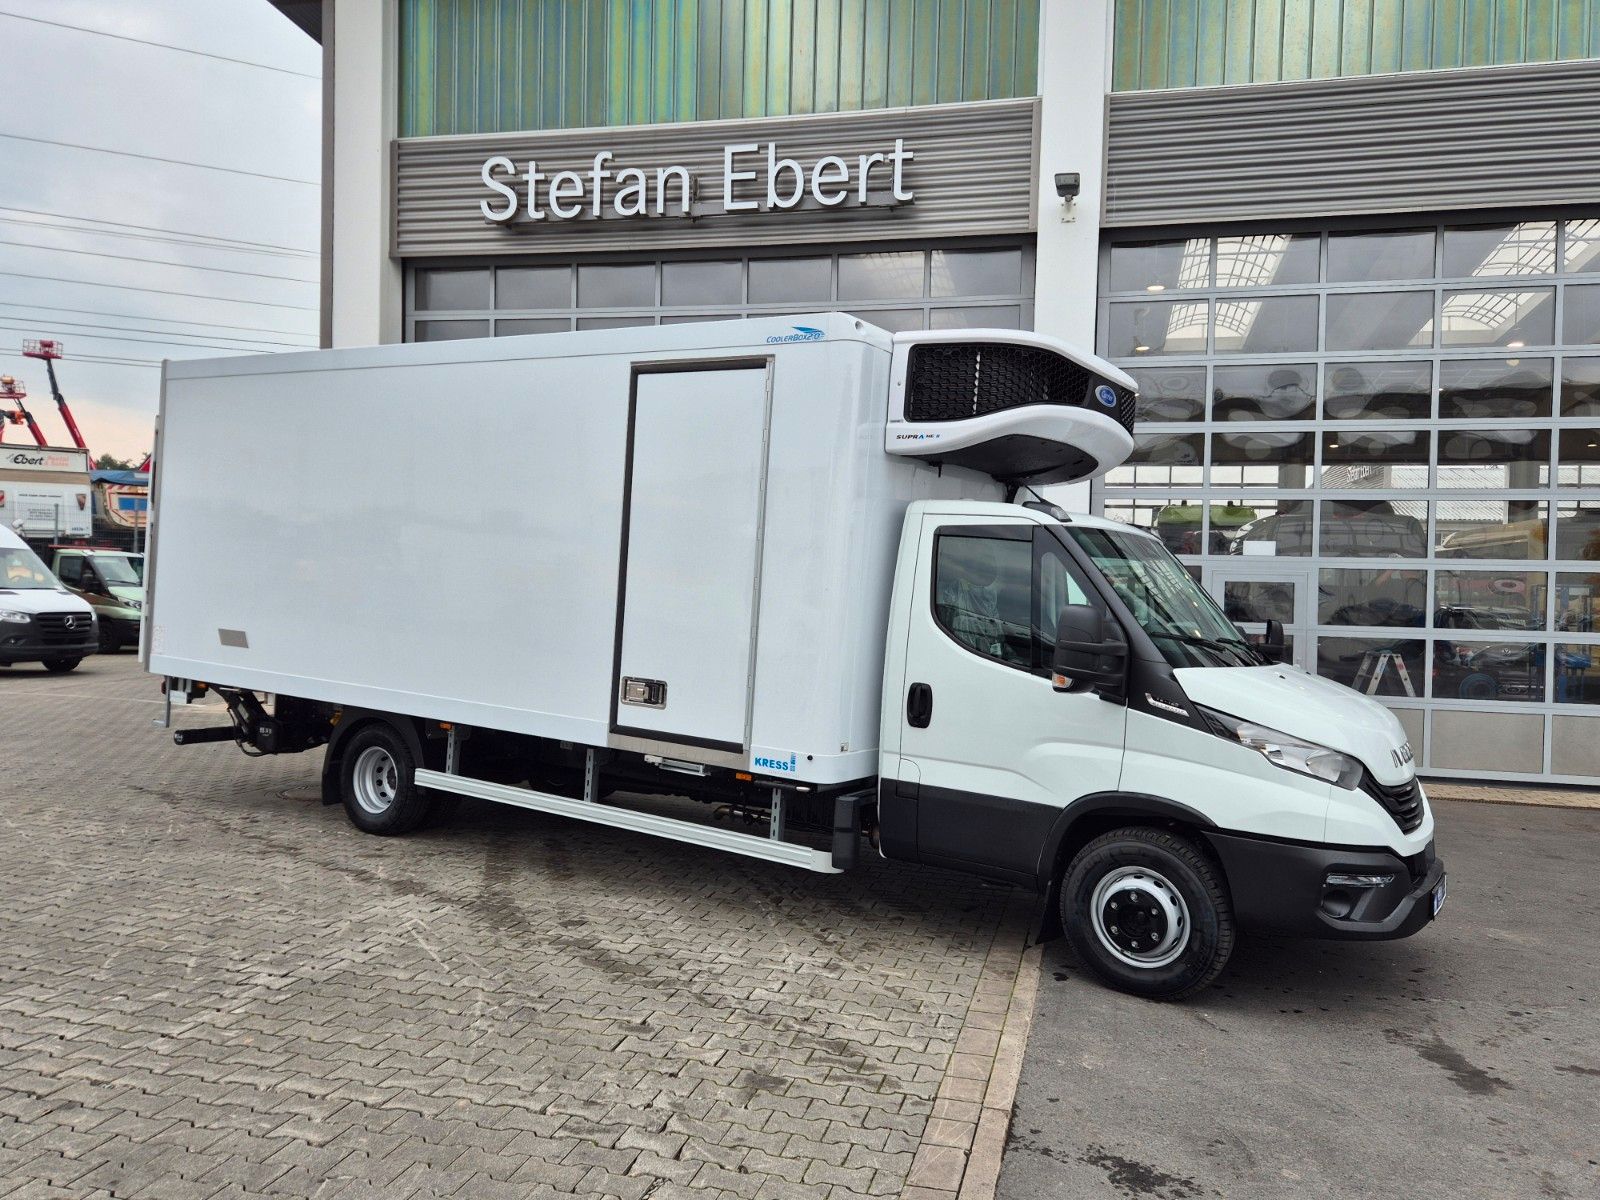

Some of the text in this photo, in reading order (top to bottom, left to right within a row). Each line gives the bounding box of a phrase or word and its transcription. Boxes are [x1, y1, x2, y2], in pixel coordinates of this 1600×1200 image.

[480, 138, 915, 223] Stefan Ebert
[14, 454, 44, 466] Ebert
[754, 757, 789, 771] KRESS
